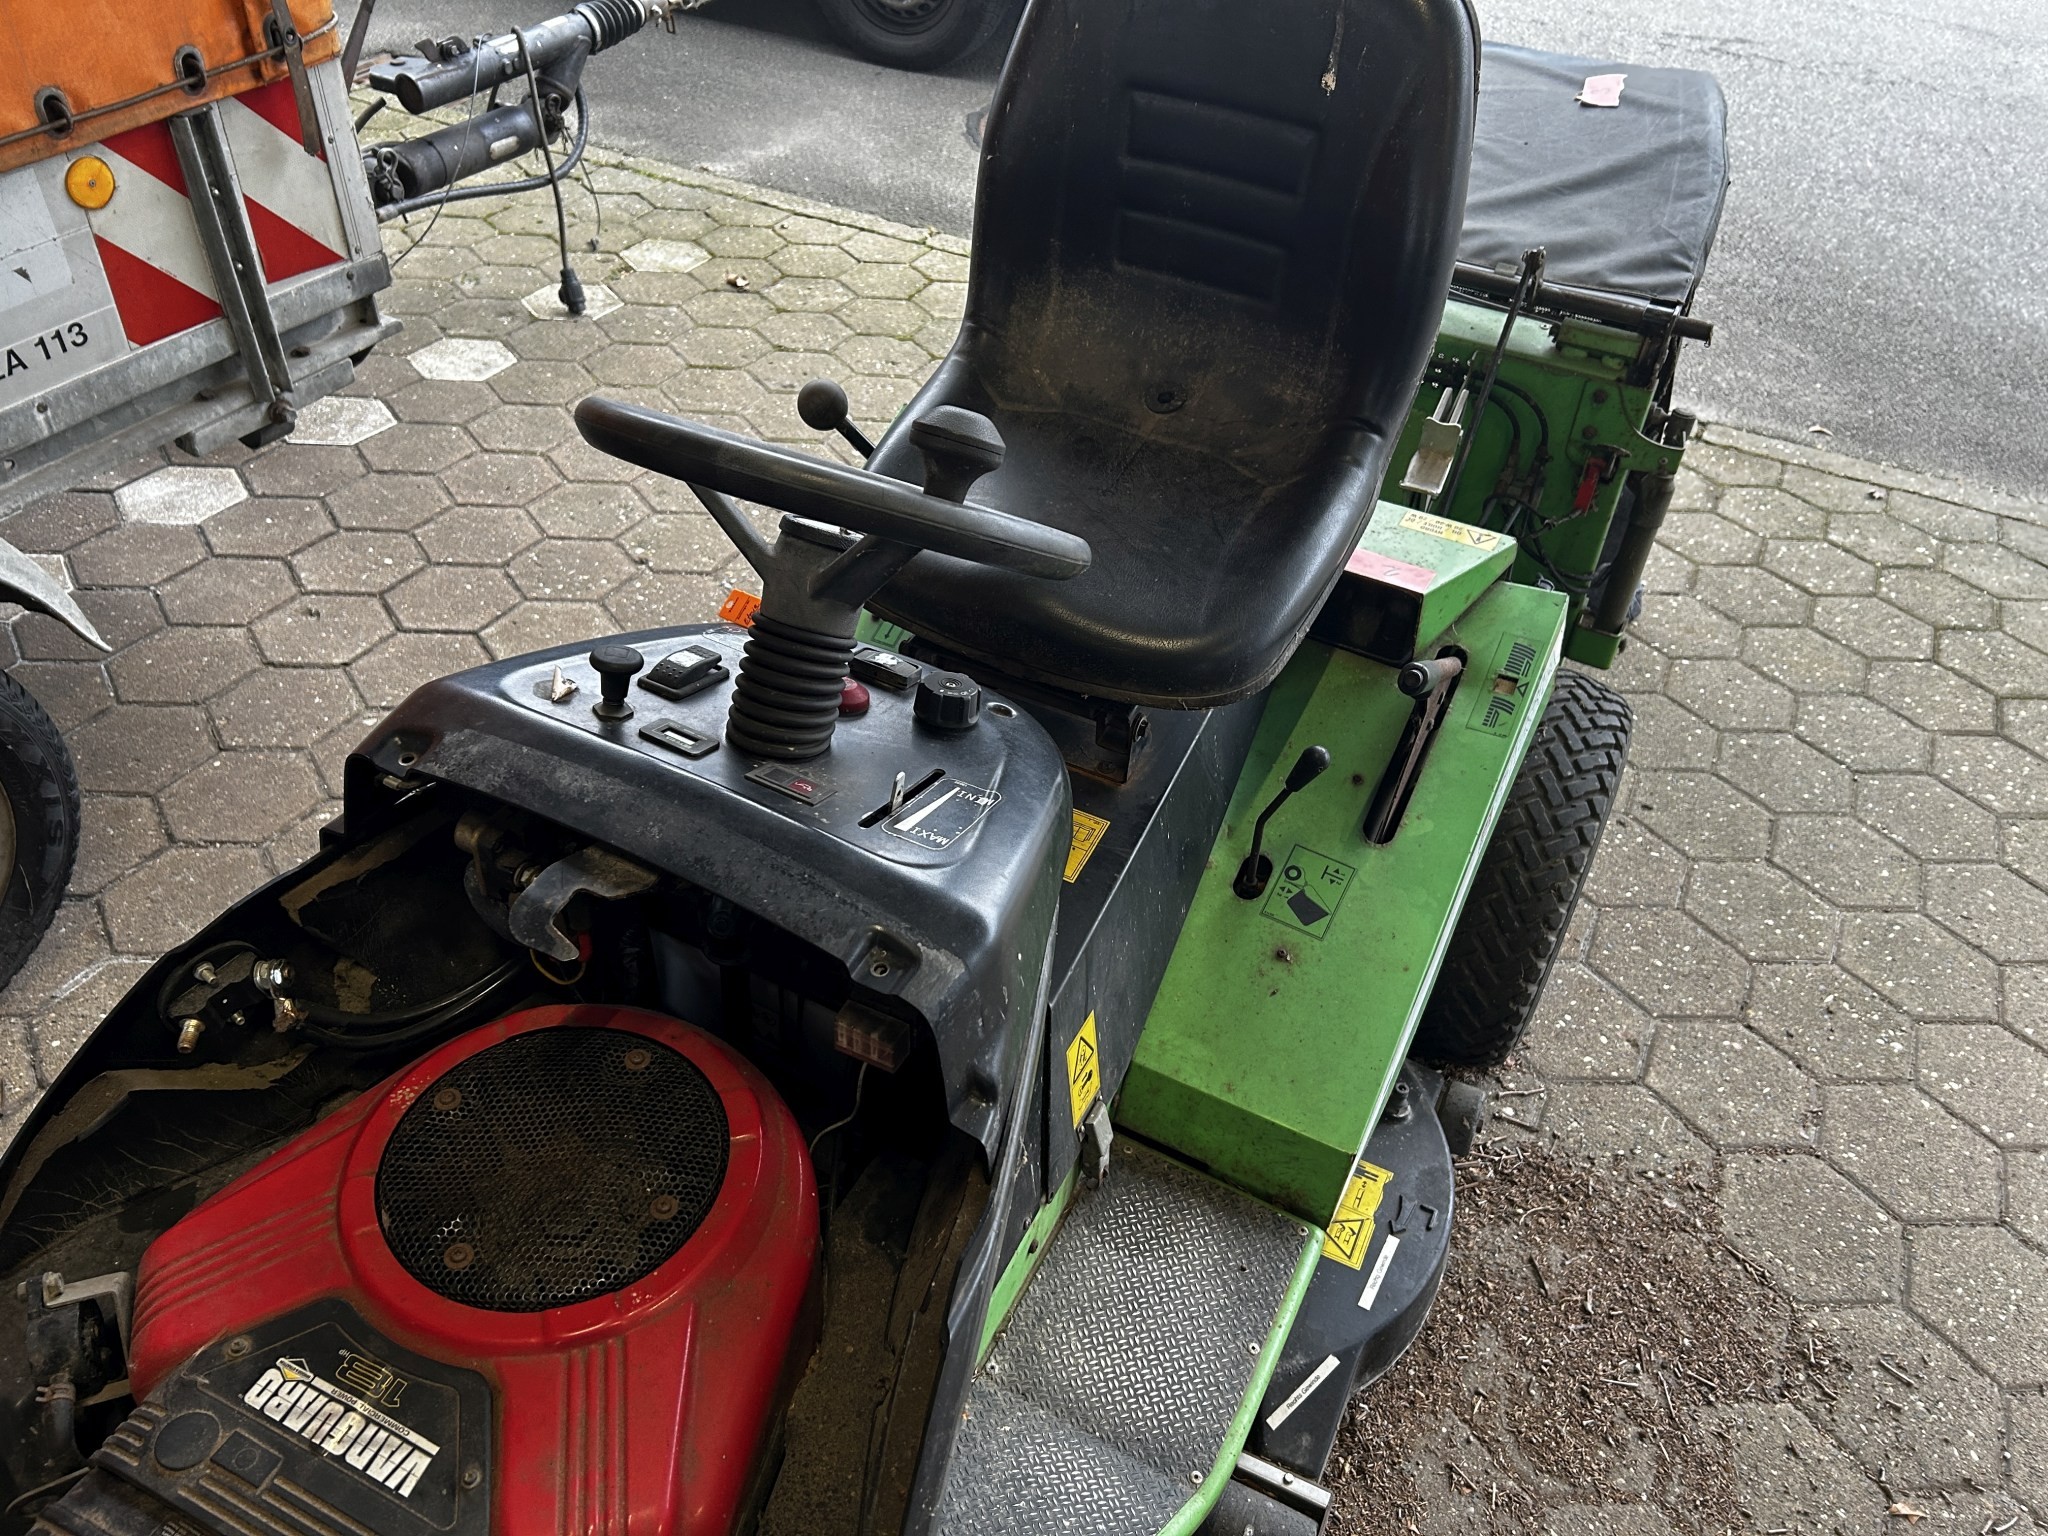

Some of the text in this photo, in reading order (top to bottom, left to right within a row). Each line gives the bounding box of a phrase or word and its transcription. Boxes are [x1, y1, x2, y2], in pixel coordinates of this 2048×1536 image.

[0, 322, 88, 380] A 113
[957, 790, 995, 806] MINI
[909, 826, 950, 846] MAXI
[335, 1348, 408, 1408] 18 HP
[1301, 1374, 1322, 1397] Gewinde
[243, 1367, 433, 1498] VANGUARD
[330, 1387, 411, 1437] COMMERCIAL POWER
